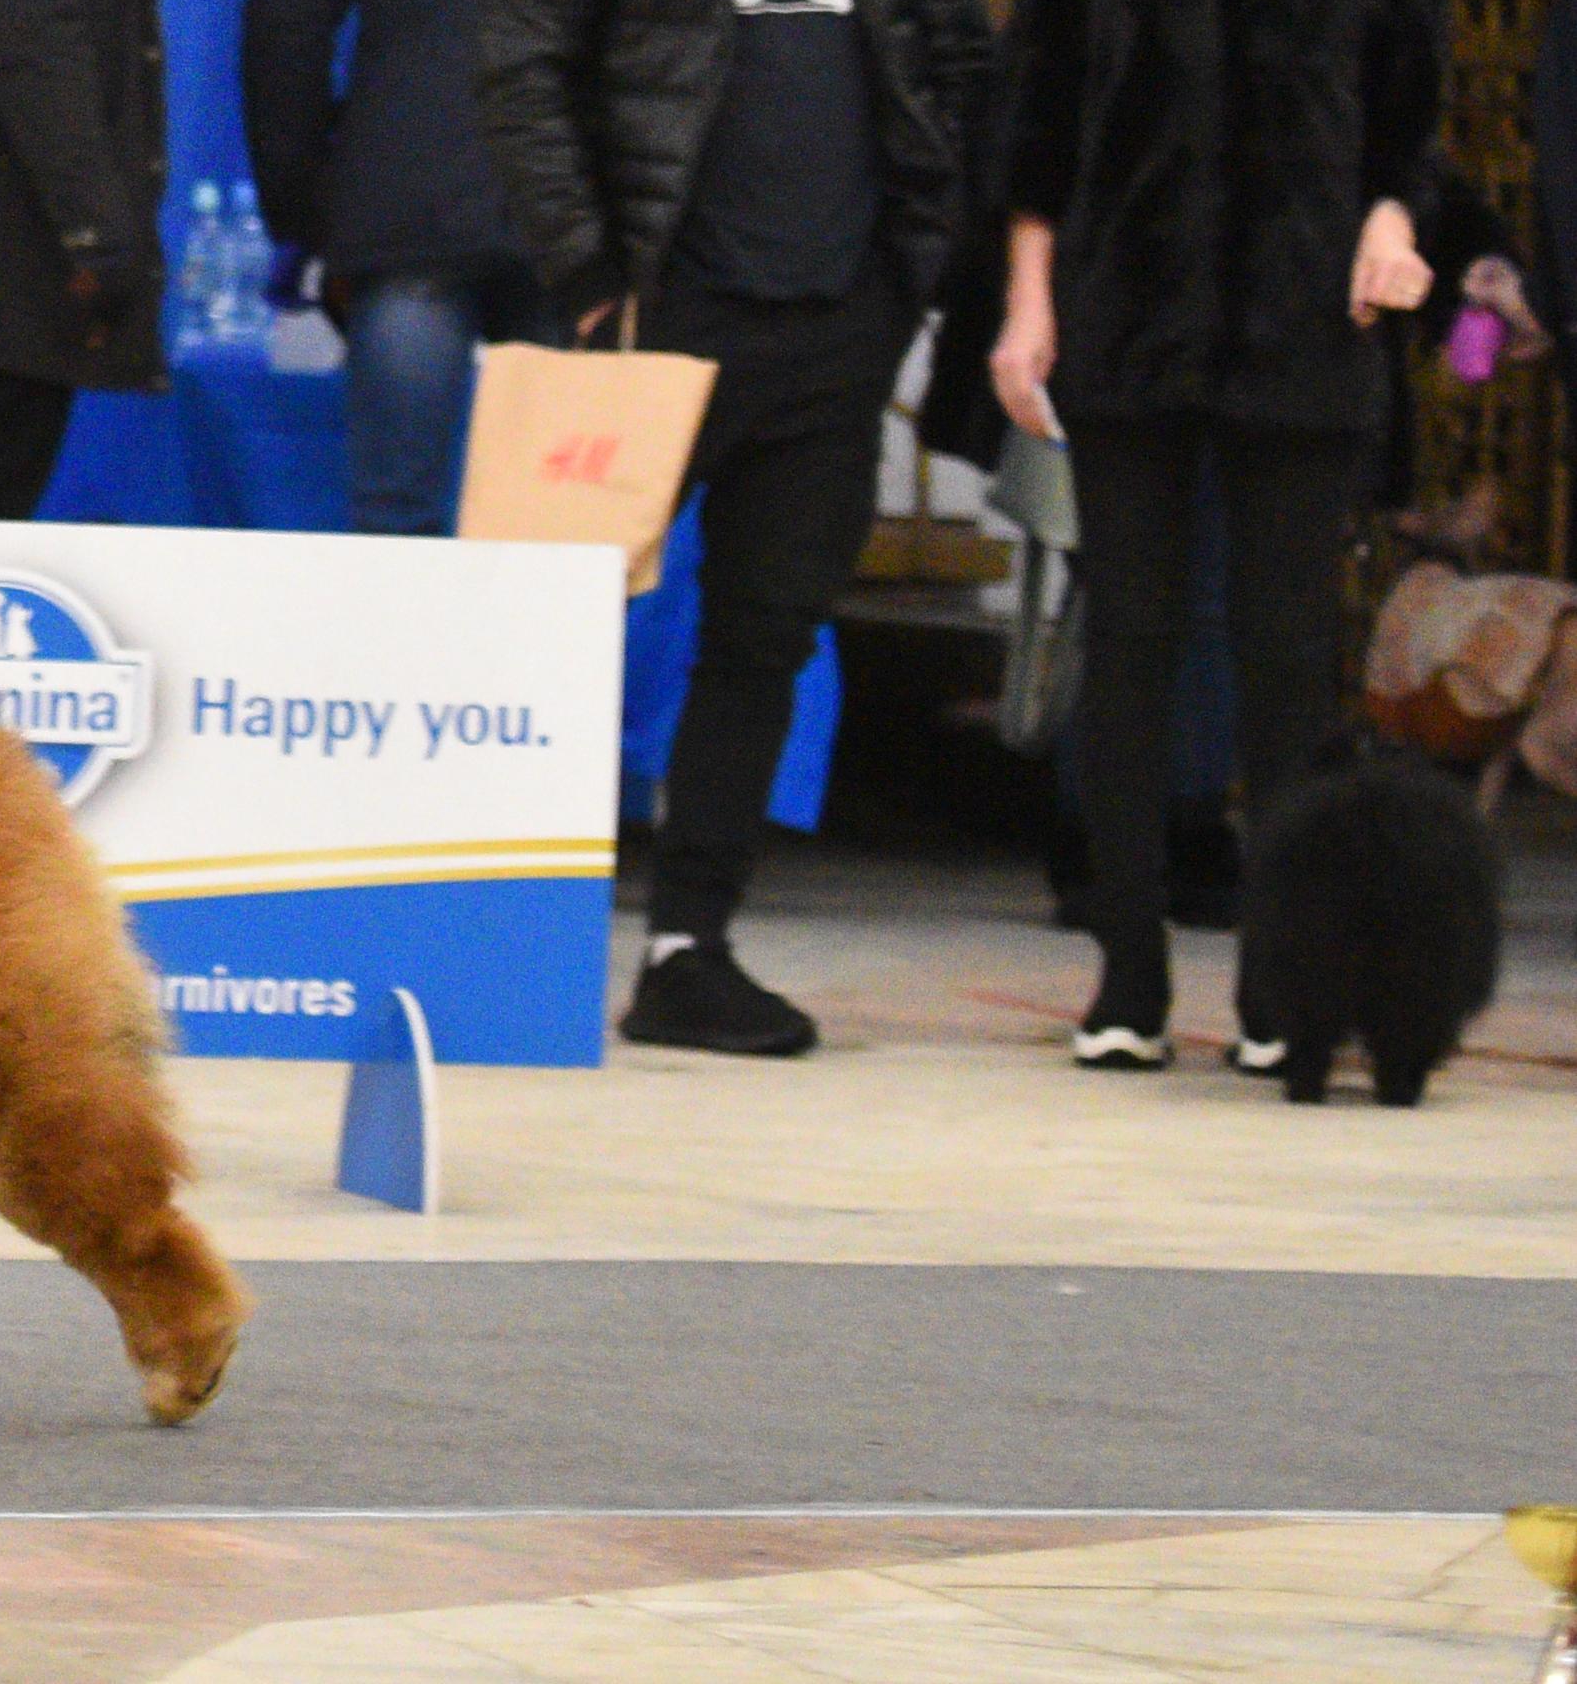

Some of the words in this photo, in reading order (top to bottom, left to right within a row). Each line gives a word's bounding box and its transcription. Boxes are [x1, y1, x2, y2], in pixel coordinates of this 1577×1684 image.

[190, 677, 396, 759] Happy
[417, 702, 551, 761] you.
[158, 965, 357, 1017] rnivores
